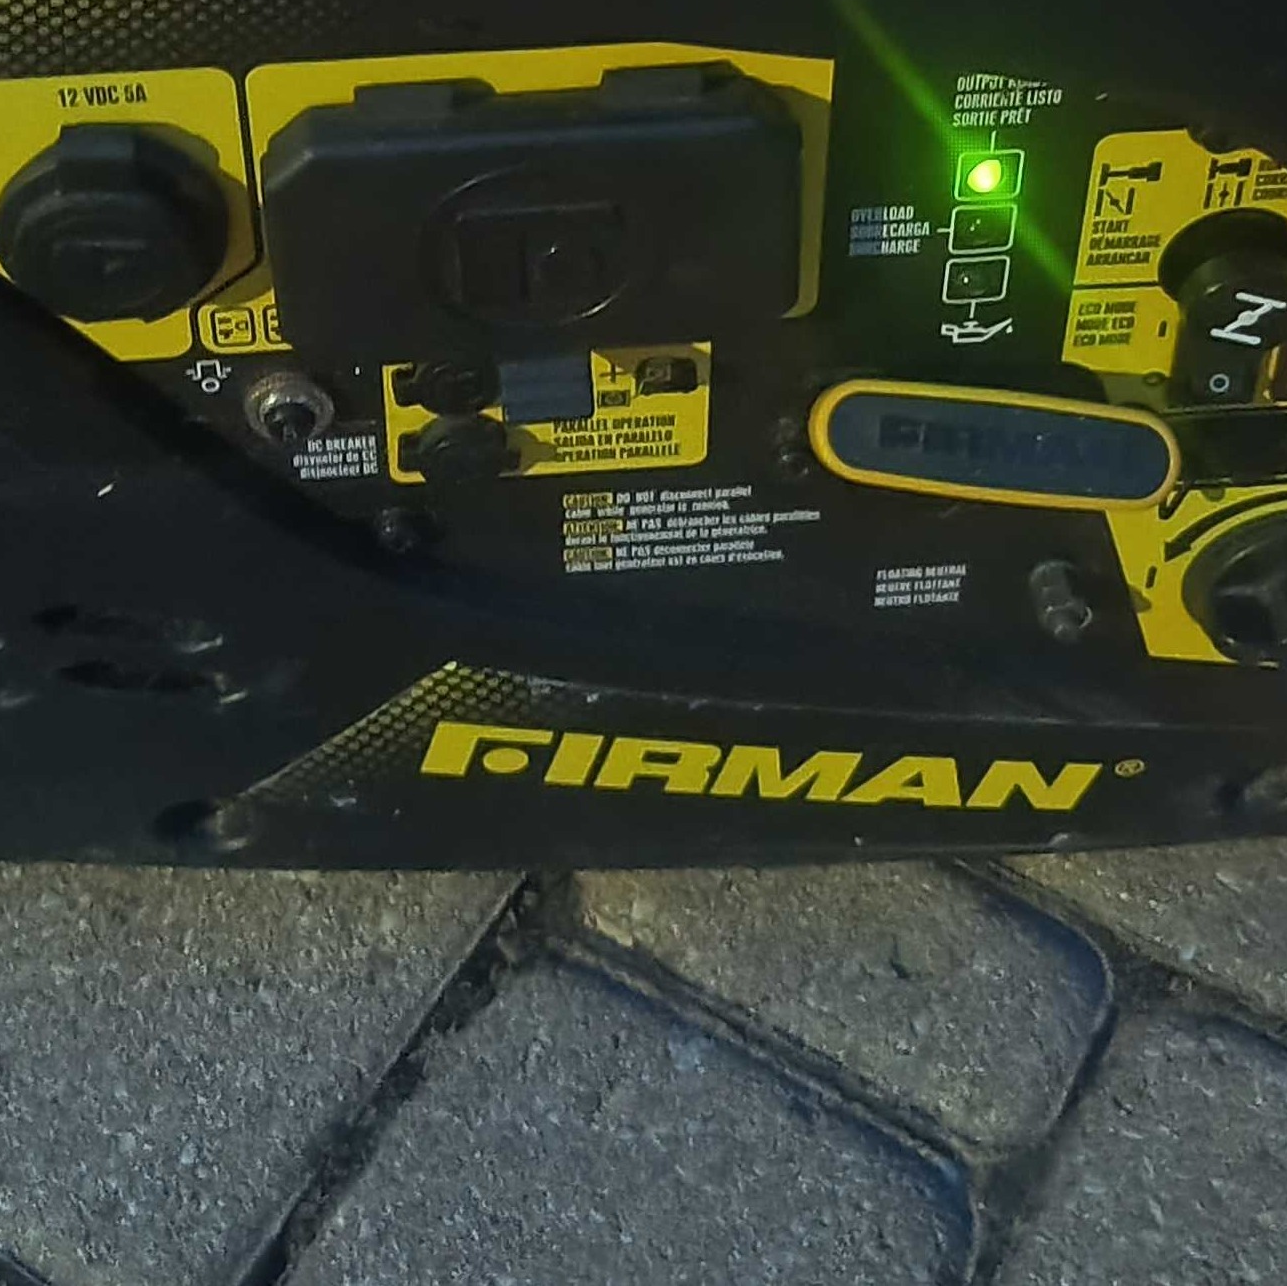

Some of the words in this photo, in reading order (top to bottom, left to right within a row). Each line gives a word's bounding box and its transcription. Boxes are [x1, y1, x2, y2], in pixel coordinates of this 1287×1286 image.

[956, 74, 1005, 92] OUTPUT
[57, 87, 78, 108] 12
[83, 85, 120, 107] VDC
[123, 81, 148, 104] 5A
[955, 91, 1024, 110] CORRIENTE
[1026, 88, 1063, 106] LISTO
[952, 110, 999, 127] SORTIE
[1092, 220, 1130, 235] START
[612, 414, 676, 430] OPERATION
[420, 721, 1105, 812] FIRMAN
